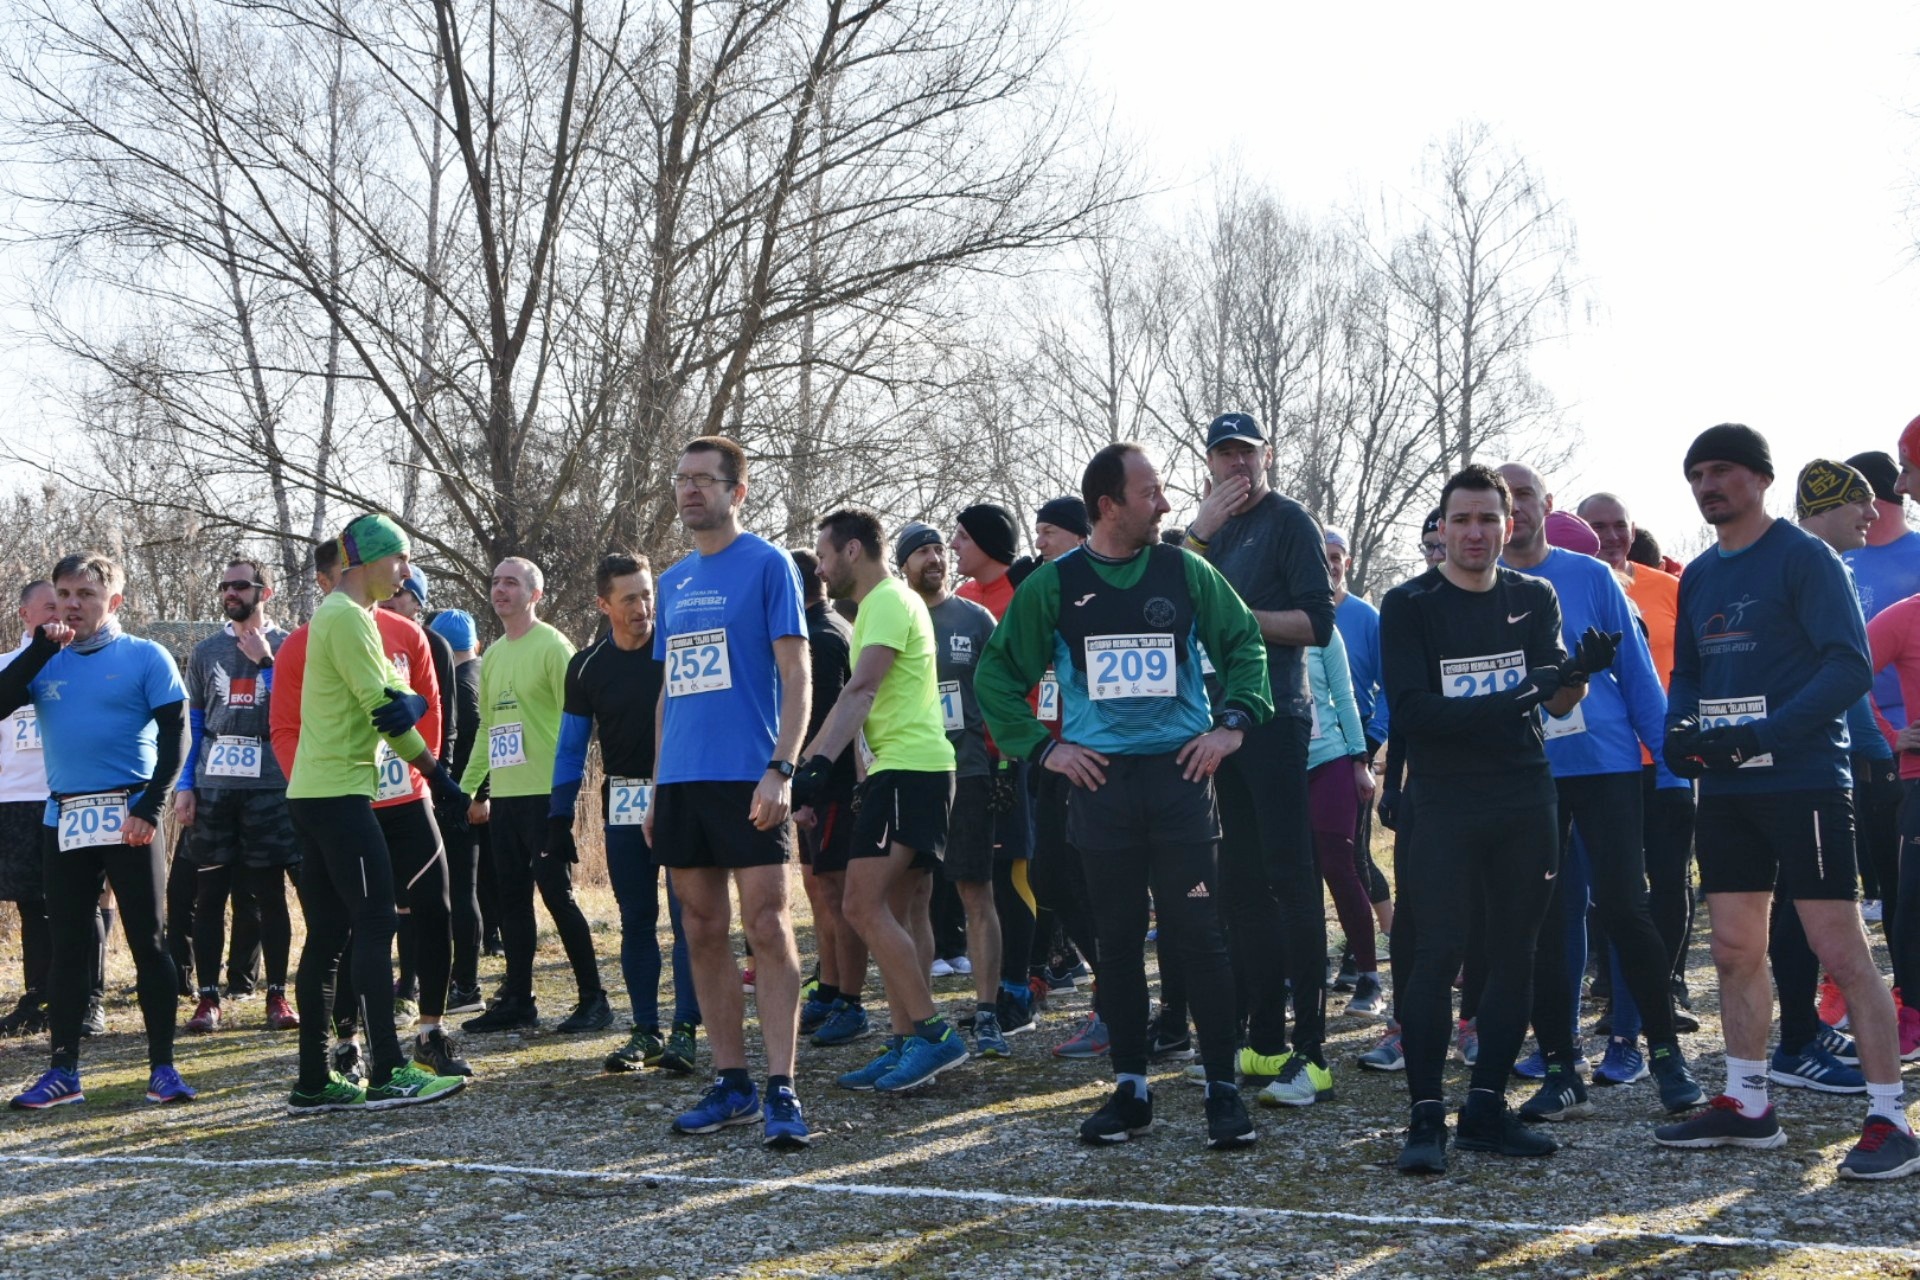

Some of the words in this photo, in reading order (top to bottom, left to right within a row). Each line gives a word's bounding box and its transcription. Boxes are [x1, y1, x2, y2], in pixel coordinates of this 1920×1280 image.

[669, 645, 722, 681] 252
[1096, 650, 1167, 684] 209
[1454, 669, 1519, 698] 218
[230, 693, 254, 704] EKO
[212, 745, 256, 768] 268
[491, 733, 519, 758] 269
[616, 786, 653, 813] 24
[65, 806, 122, 838] 205
